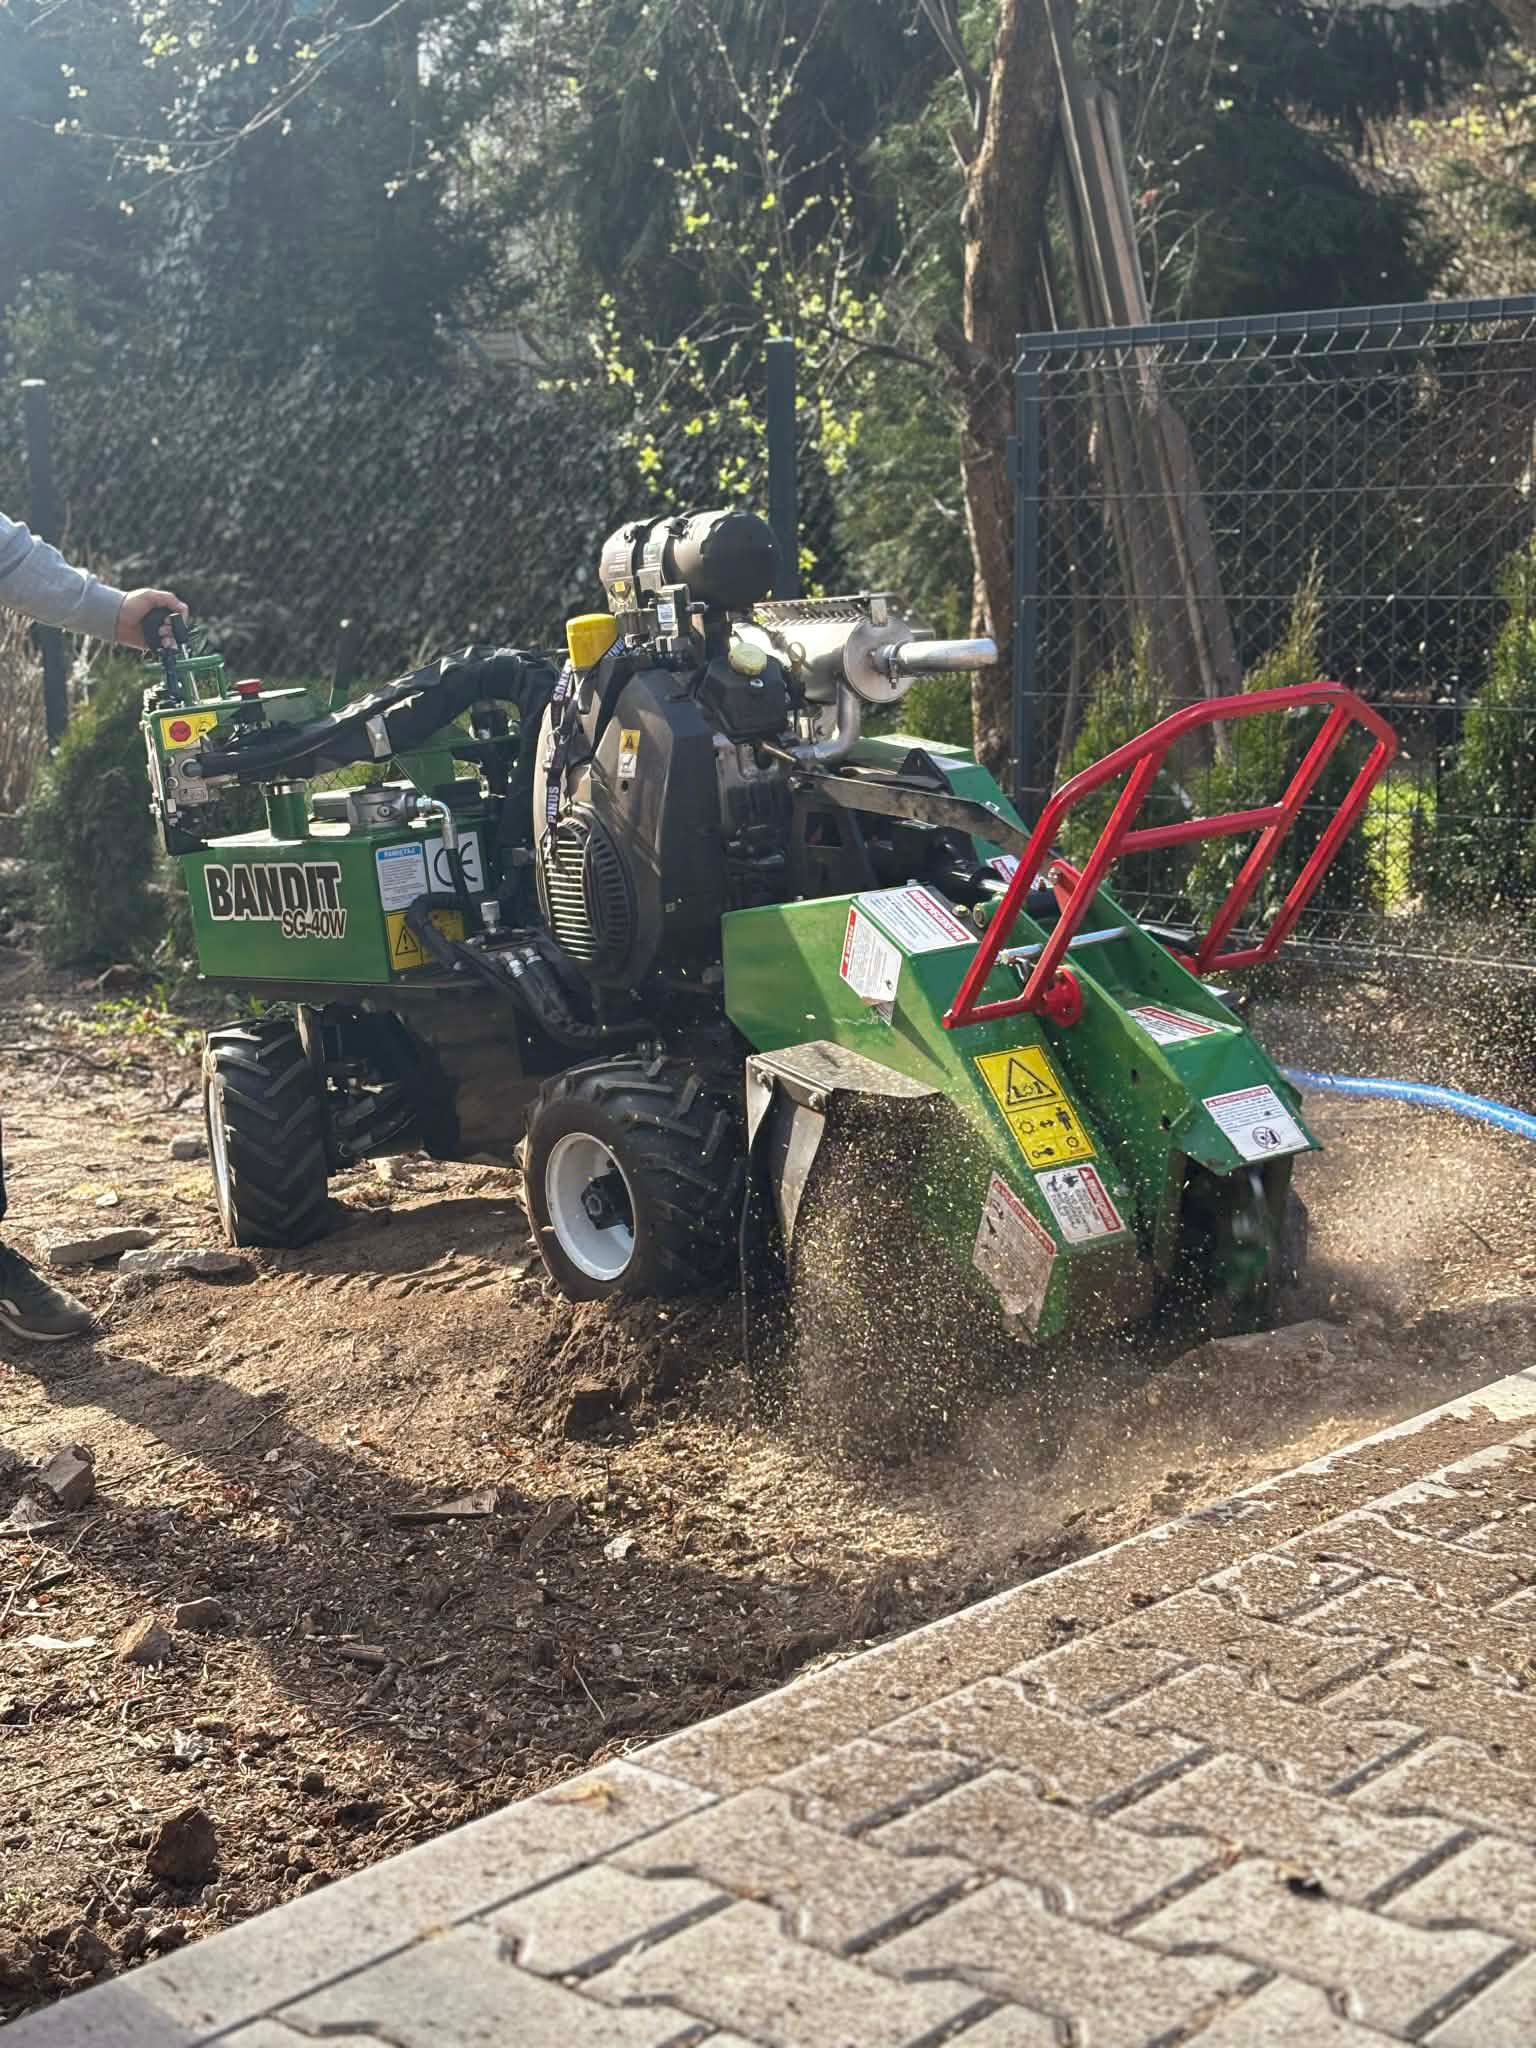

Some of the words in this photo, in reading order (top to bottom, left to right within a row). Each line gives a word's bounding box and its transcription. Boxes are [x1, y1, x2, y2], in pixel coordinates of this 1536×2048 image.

[548, 786, 559, 823] PINUS
[204, 862, 341, 920] BANDIT
[282, 908, 347, 939] SG-40W
